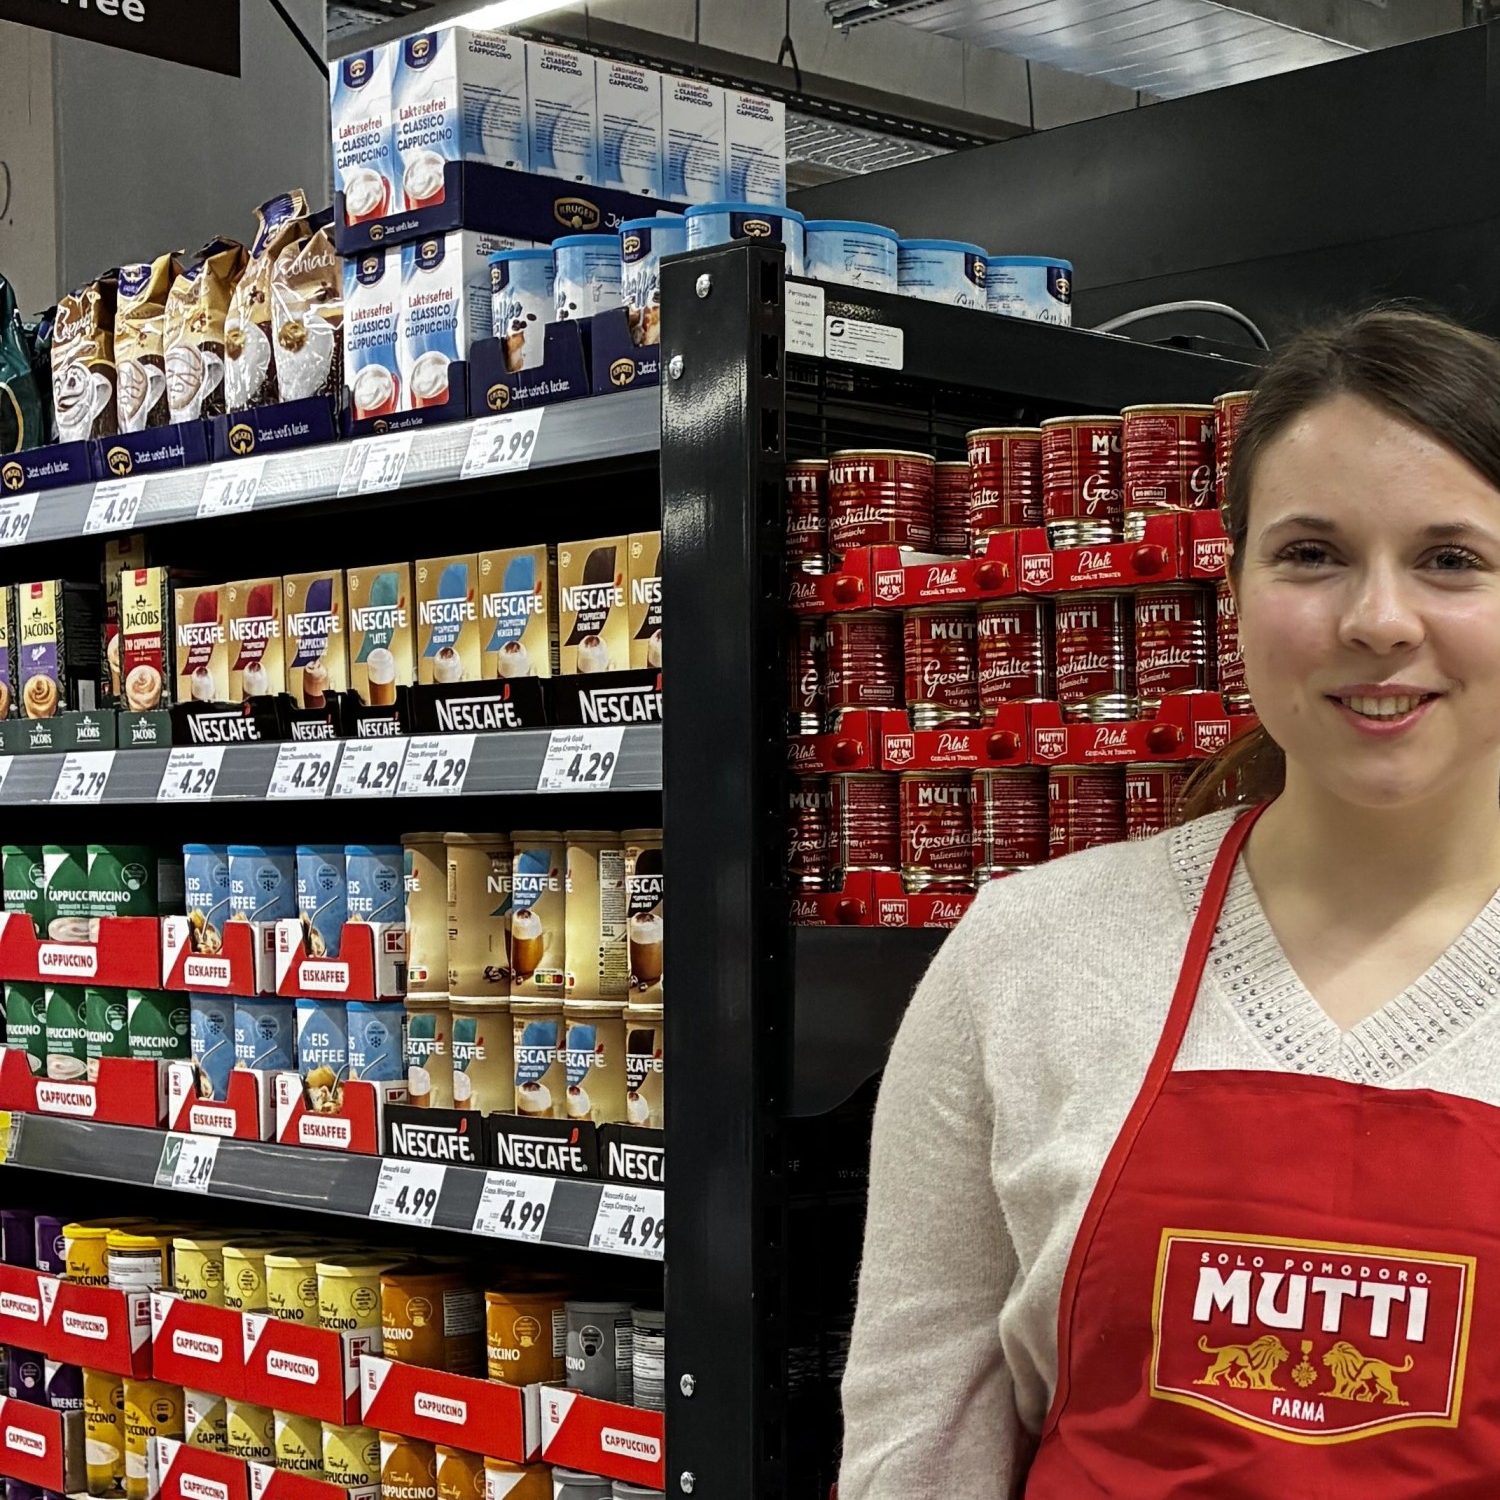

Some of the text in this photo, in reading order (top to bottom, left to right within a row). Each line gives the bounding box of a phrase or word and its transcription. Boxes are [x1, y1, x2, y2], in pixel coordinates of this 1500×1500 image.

[401, 114, 444, 135] CLASSICO
[342, 132, 381, 153] CLASSICO
[411, 303, 450, 320] CLASSICO
[353, 318, 390, 336] CLASSICO
[486, 429, 535, 463] 2.99
[104, 496, 138, 523] 4.99
[1078, 551, 1112, 571] Pelati
[126, 610, 159, 630] JACOBS
[23, 622, 54, 640] JACOBS
[76, 727, 100, 740] JACOBS
[132, 728, 157, 741] JACOBS
[291, 761, 331, 788] 4.29
[357, 761, 398, 789] 4.29
[423, 758, 466, 787] 4.29
[567, 752, 614, 782] 4.29
[72, 771, 106, 796] 2.79
[180, 768, 216, 794] 4.29
[42, 953, 93, 968] CAPPUCCINO
[188, 964, 227, 979] EISKAFFEE
[303, 969, 345, 984] EISKAFFEE
[311, 1033, 329, 1046] EIS
[302, 1049, 345, 1063] KAFFEE
[40, 1089, 92, 1107] CAPPUCCINO
[193, 1113, 233, 1129] EISKAFFEE
[303, 1123, 346, 1139] EISKAFFEE
[193, 1157, 213, 1185] 2.49
[395, 1185, 436, 1217] 4.99
[500, 1200, 545, 1232] 4.99
[619, 1215, 664, 1249] 4.99
[1201, 1251, 1264, 1268] SOLO
[1192, 1266, 1429, 1342] MUTTI
[65, 1315, 105, 1333] CAPPUCCINO
[176, 1336, 219, 1355] CAPPUCCINO
[270, 1357, 314, 1376] CAPPUCCINO
[418, 1398, 462, 1417] CAPPUCCINO
[1272, 1397, 1325, 1422] PARMA
[605, 1435, 656, 1454] CAPPUCCINO
[183, 1479, 224, 1499] CAPPUCCINO
